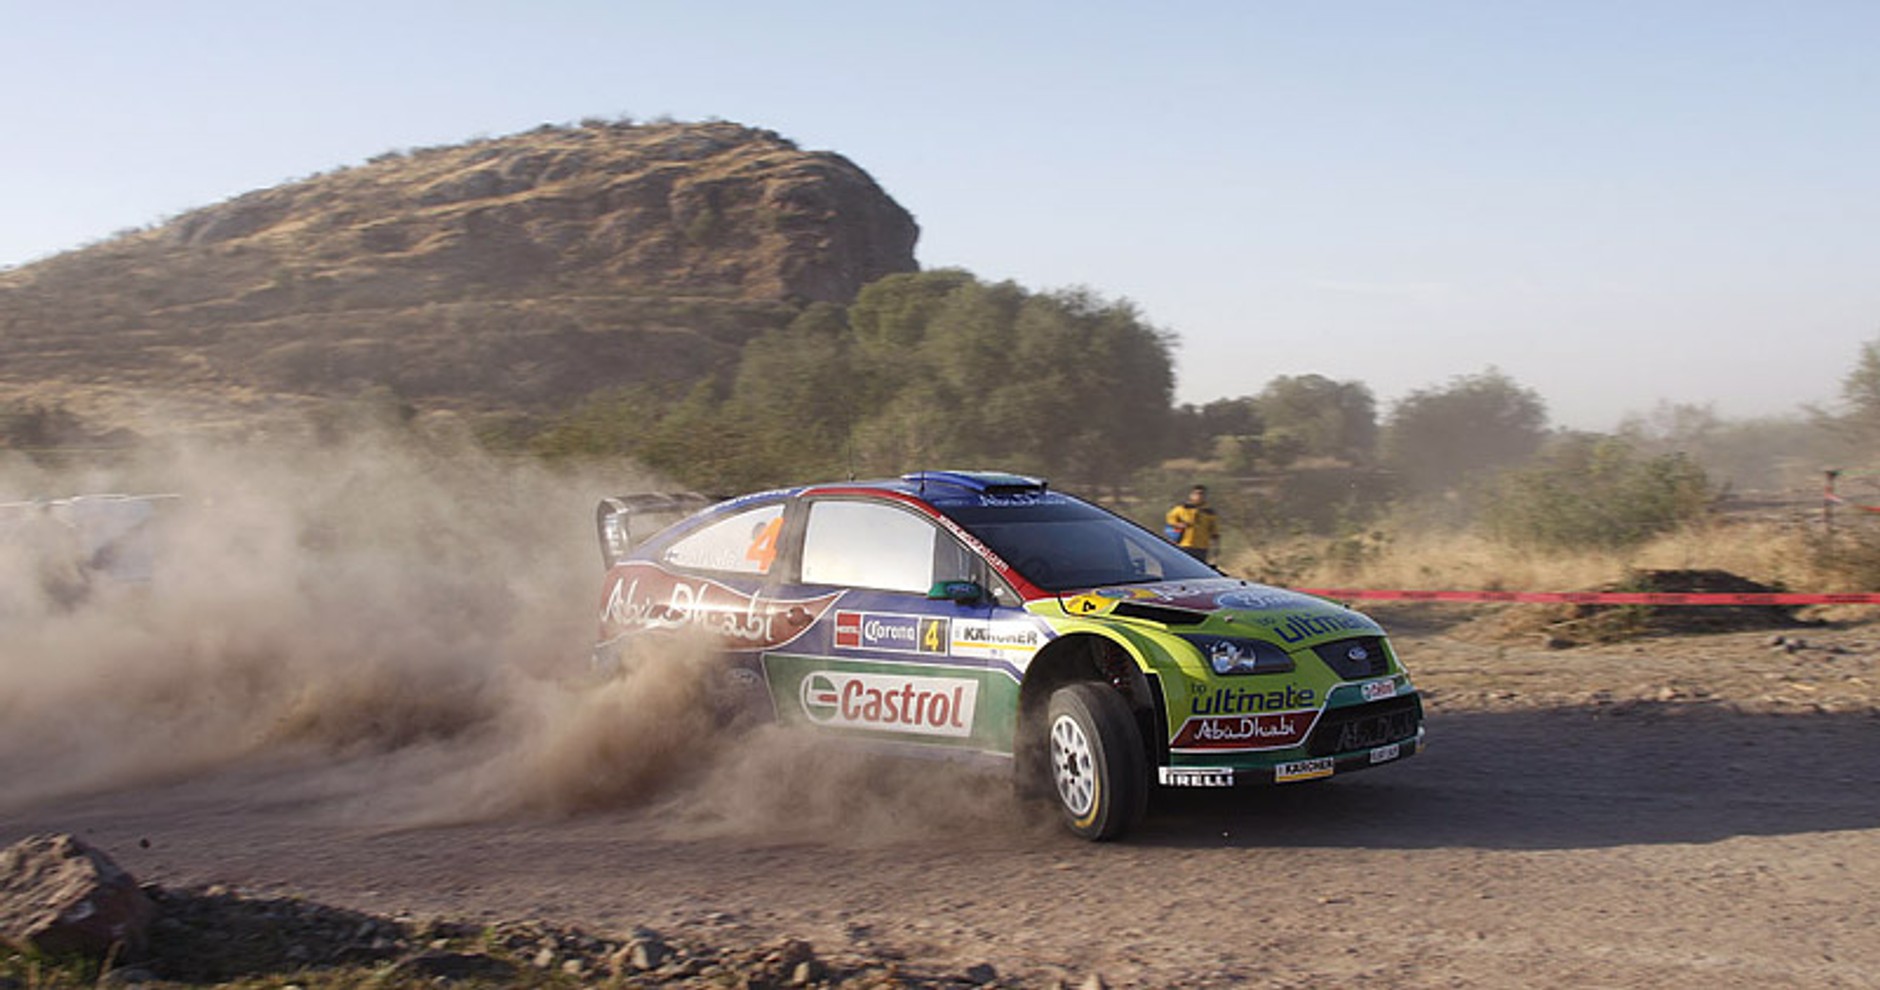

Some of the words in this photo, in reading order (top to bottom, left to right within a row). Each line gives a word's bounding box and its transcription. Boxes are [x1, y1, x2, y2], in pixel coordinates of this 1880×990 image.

[745, 516, 785, 571] 4
[864, 620, 915, 643] Corona
[924, 620, 940, 652] 4
[841, 680, 963, 728] Castrol
[1191, 685, 1315, 714] ultimate
[1159, 767, 1234, 786] PIRELLI
